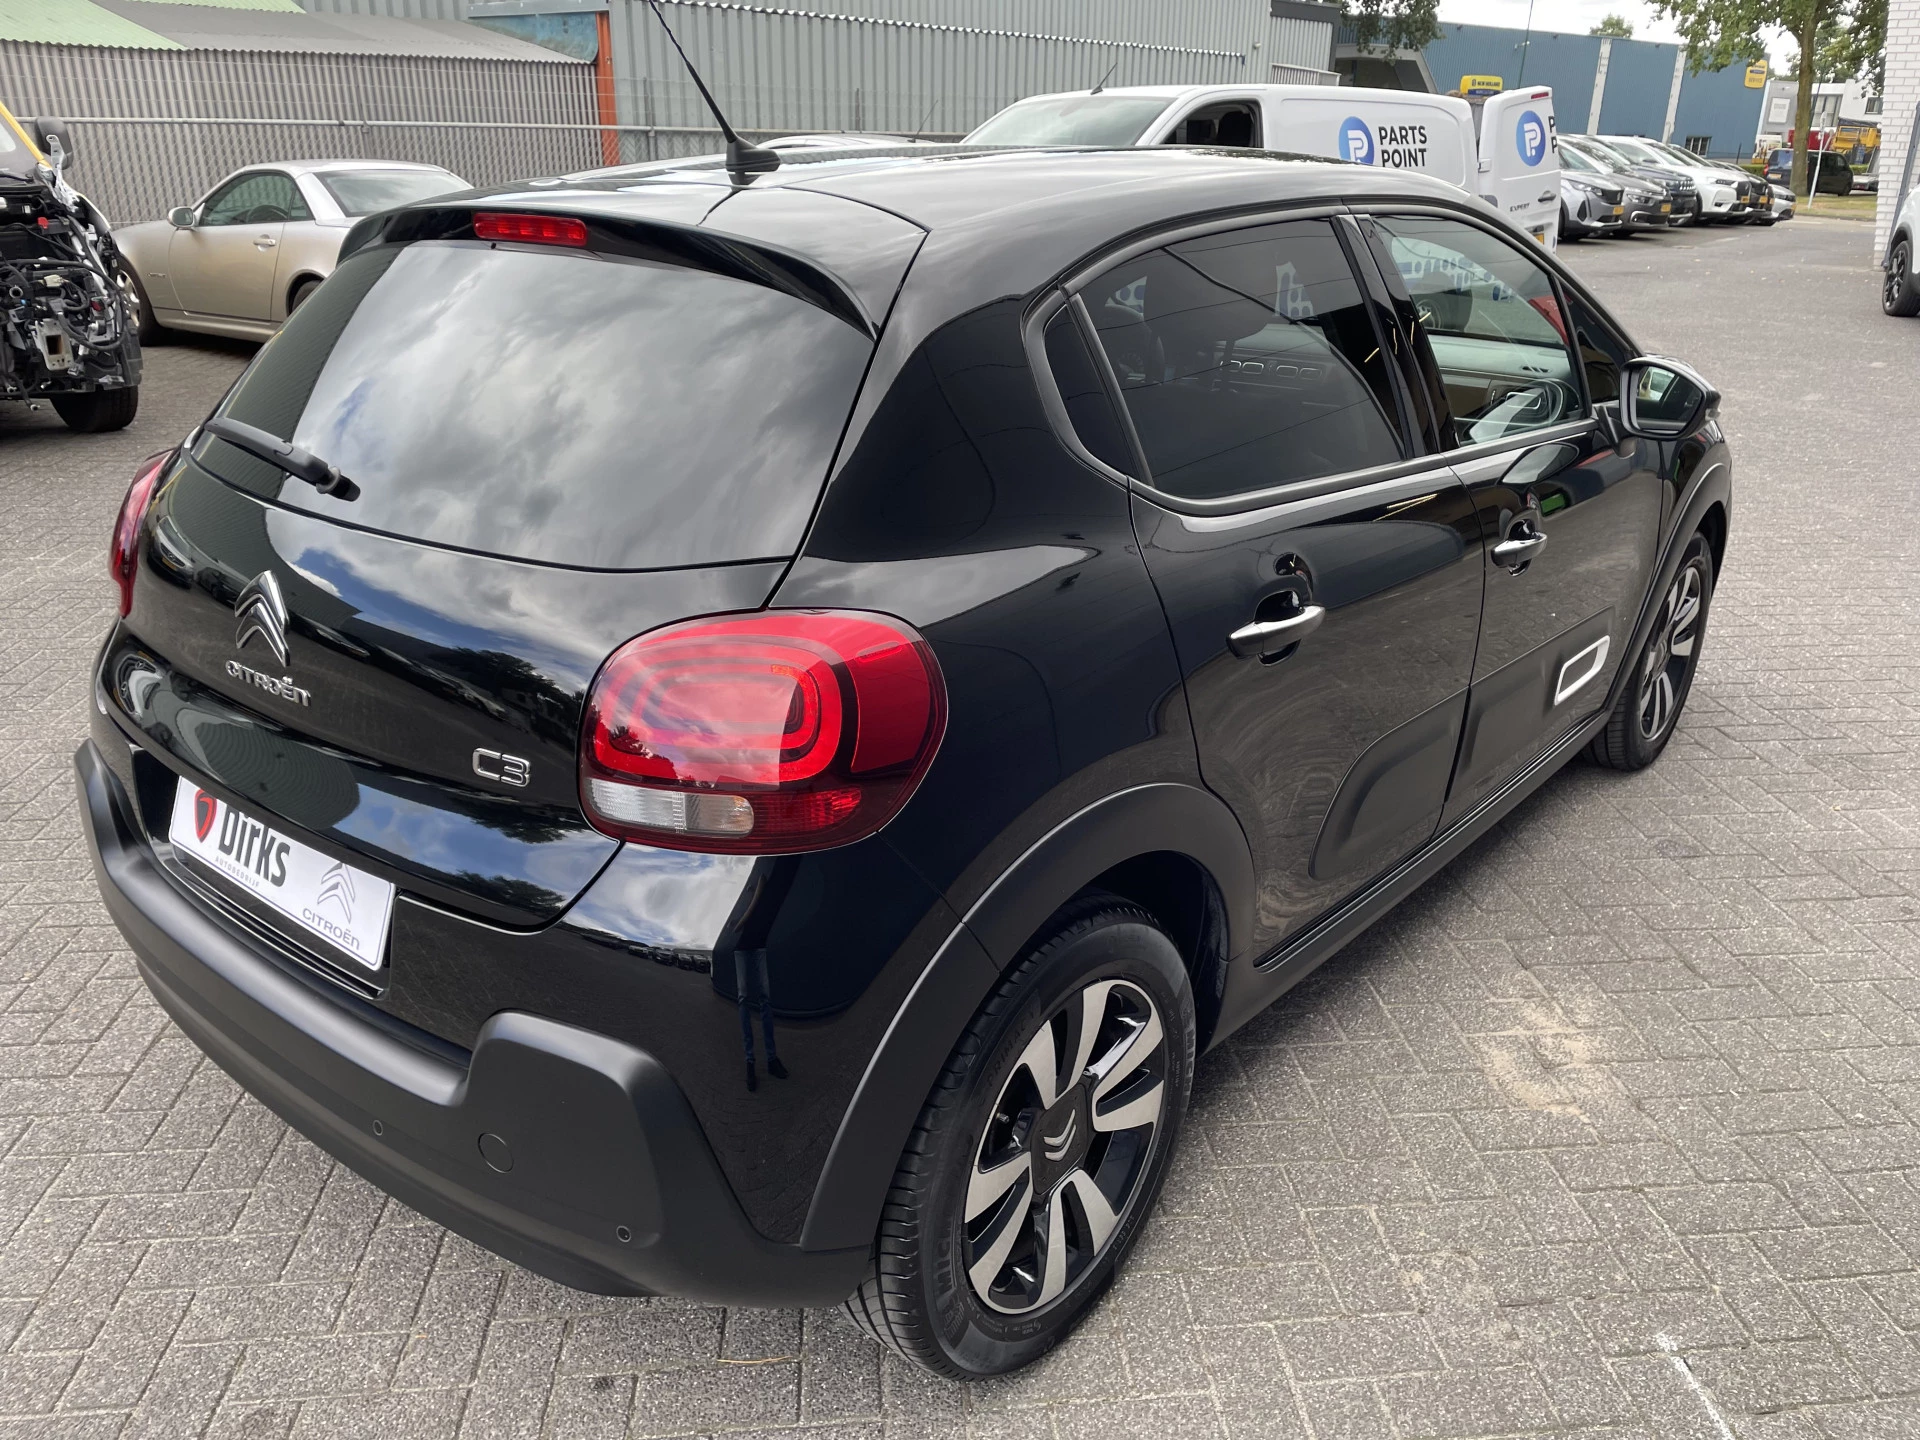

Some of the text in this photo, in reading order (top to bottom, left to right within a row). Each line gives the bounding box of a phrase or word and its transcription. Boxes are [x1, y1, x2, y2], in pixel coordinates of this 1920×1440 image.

[1378, 126, 1427, 146] PARTS
[1380, 148, 1427, 168] POINT
[472, 747, 531, 788] C3
